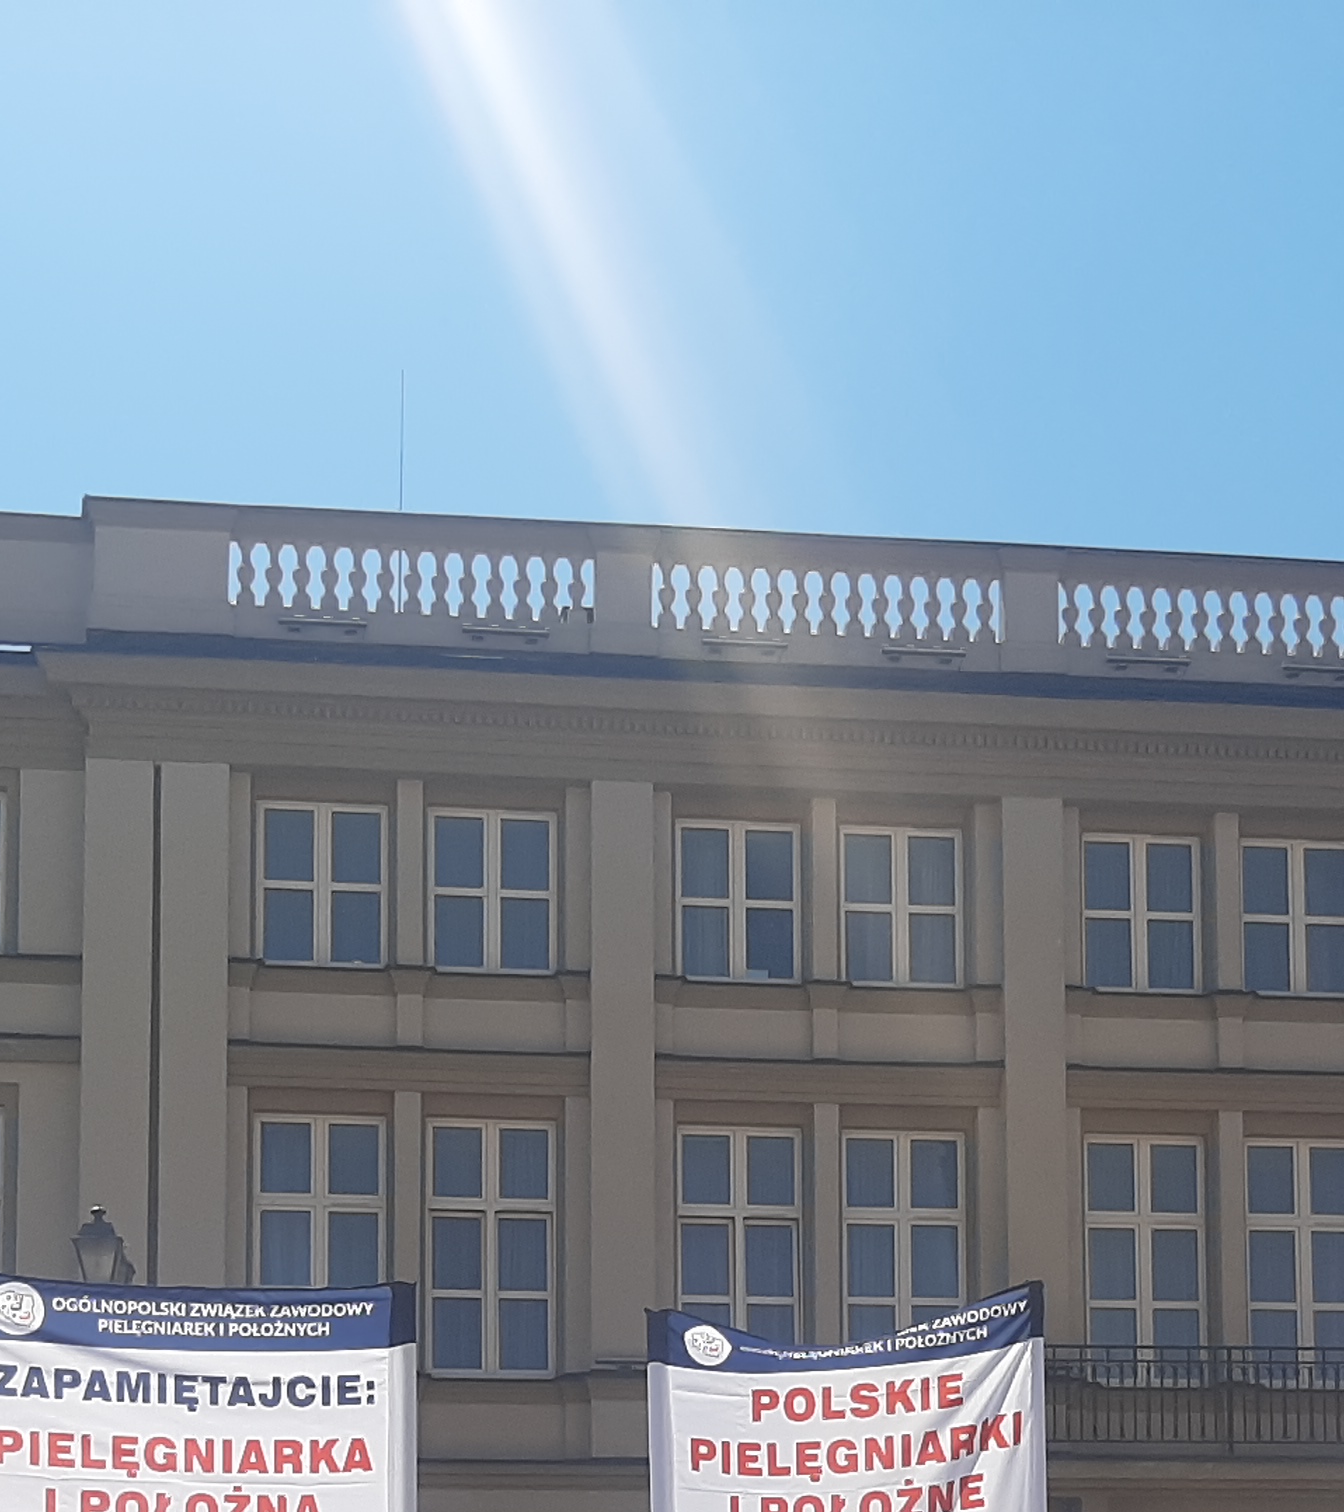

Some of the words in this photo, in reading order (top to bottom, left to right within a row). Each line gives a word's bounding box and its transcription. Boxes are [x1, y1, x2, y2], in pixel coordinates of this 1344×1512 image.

[52, 1295, 187, 1317] OGÓLNOPOLSKI
[189, 1302, 266, 1319] ZWIĄZEK
[270, 1302, 374, 1317] ZAWODOWY
[931, 1299, 1027, 1330] ZAWODOWY
[98, 1319, 216, 1337] PIELĘGNIAREK
[228, 1319, 330, 1337] POŁOŻNYCH
[895, 1326, 987, 1352] POŁOŻNYCH
[751, 1372, 963, 1422] POLSKIE
[690, 1410, 1022, 1482] PIELĘGNIARKI
